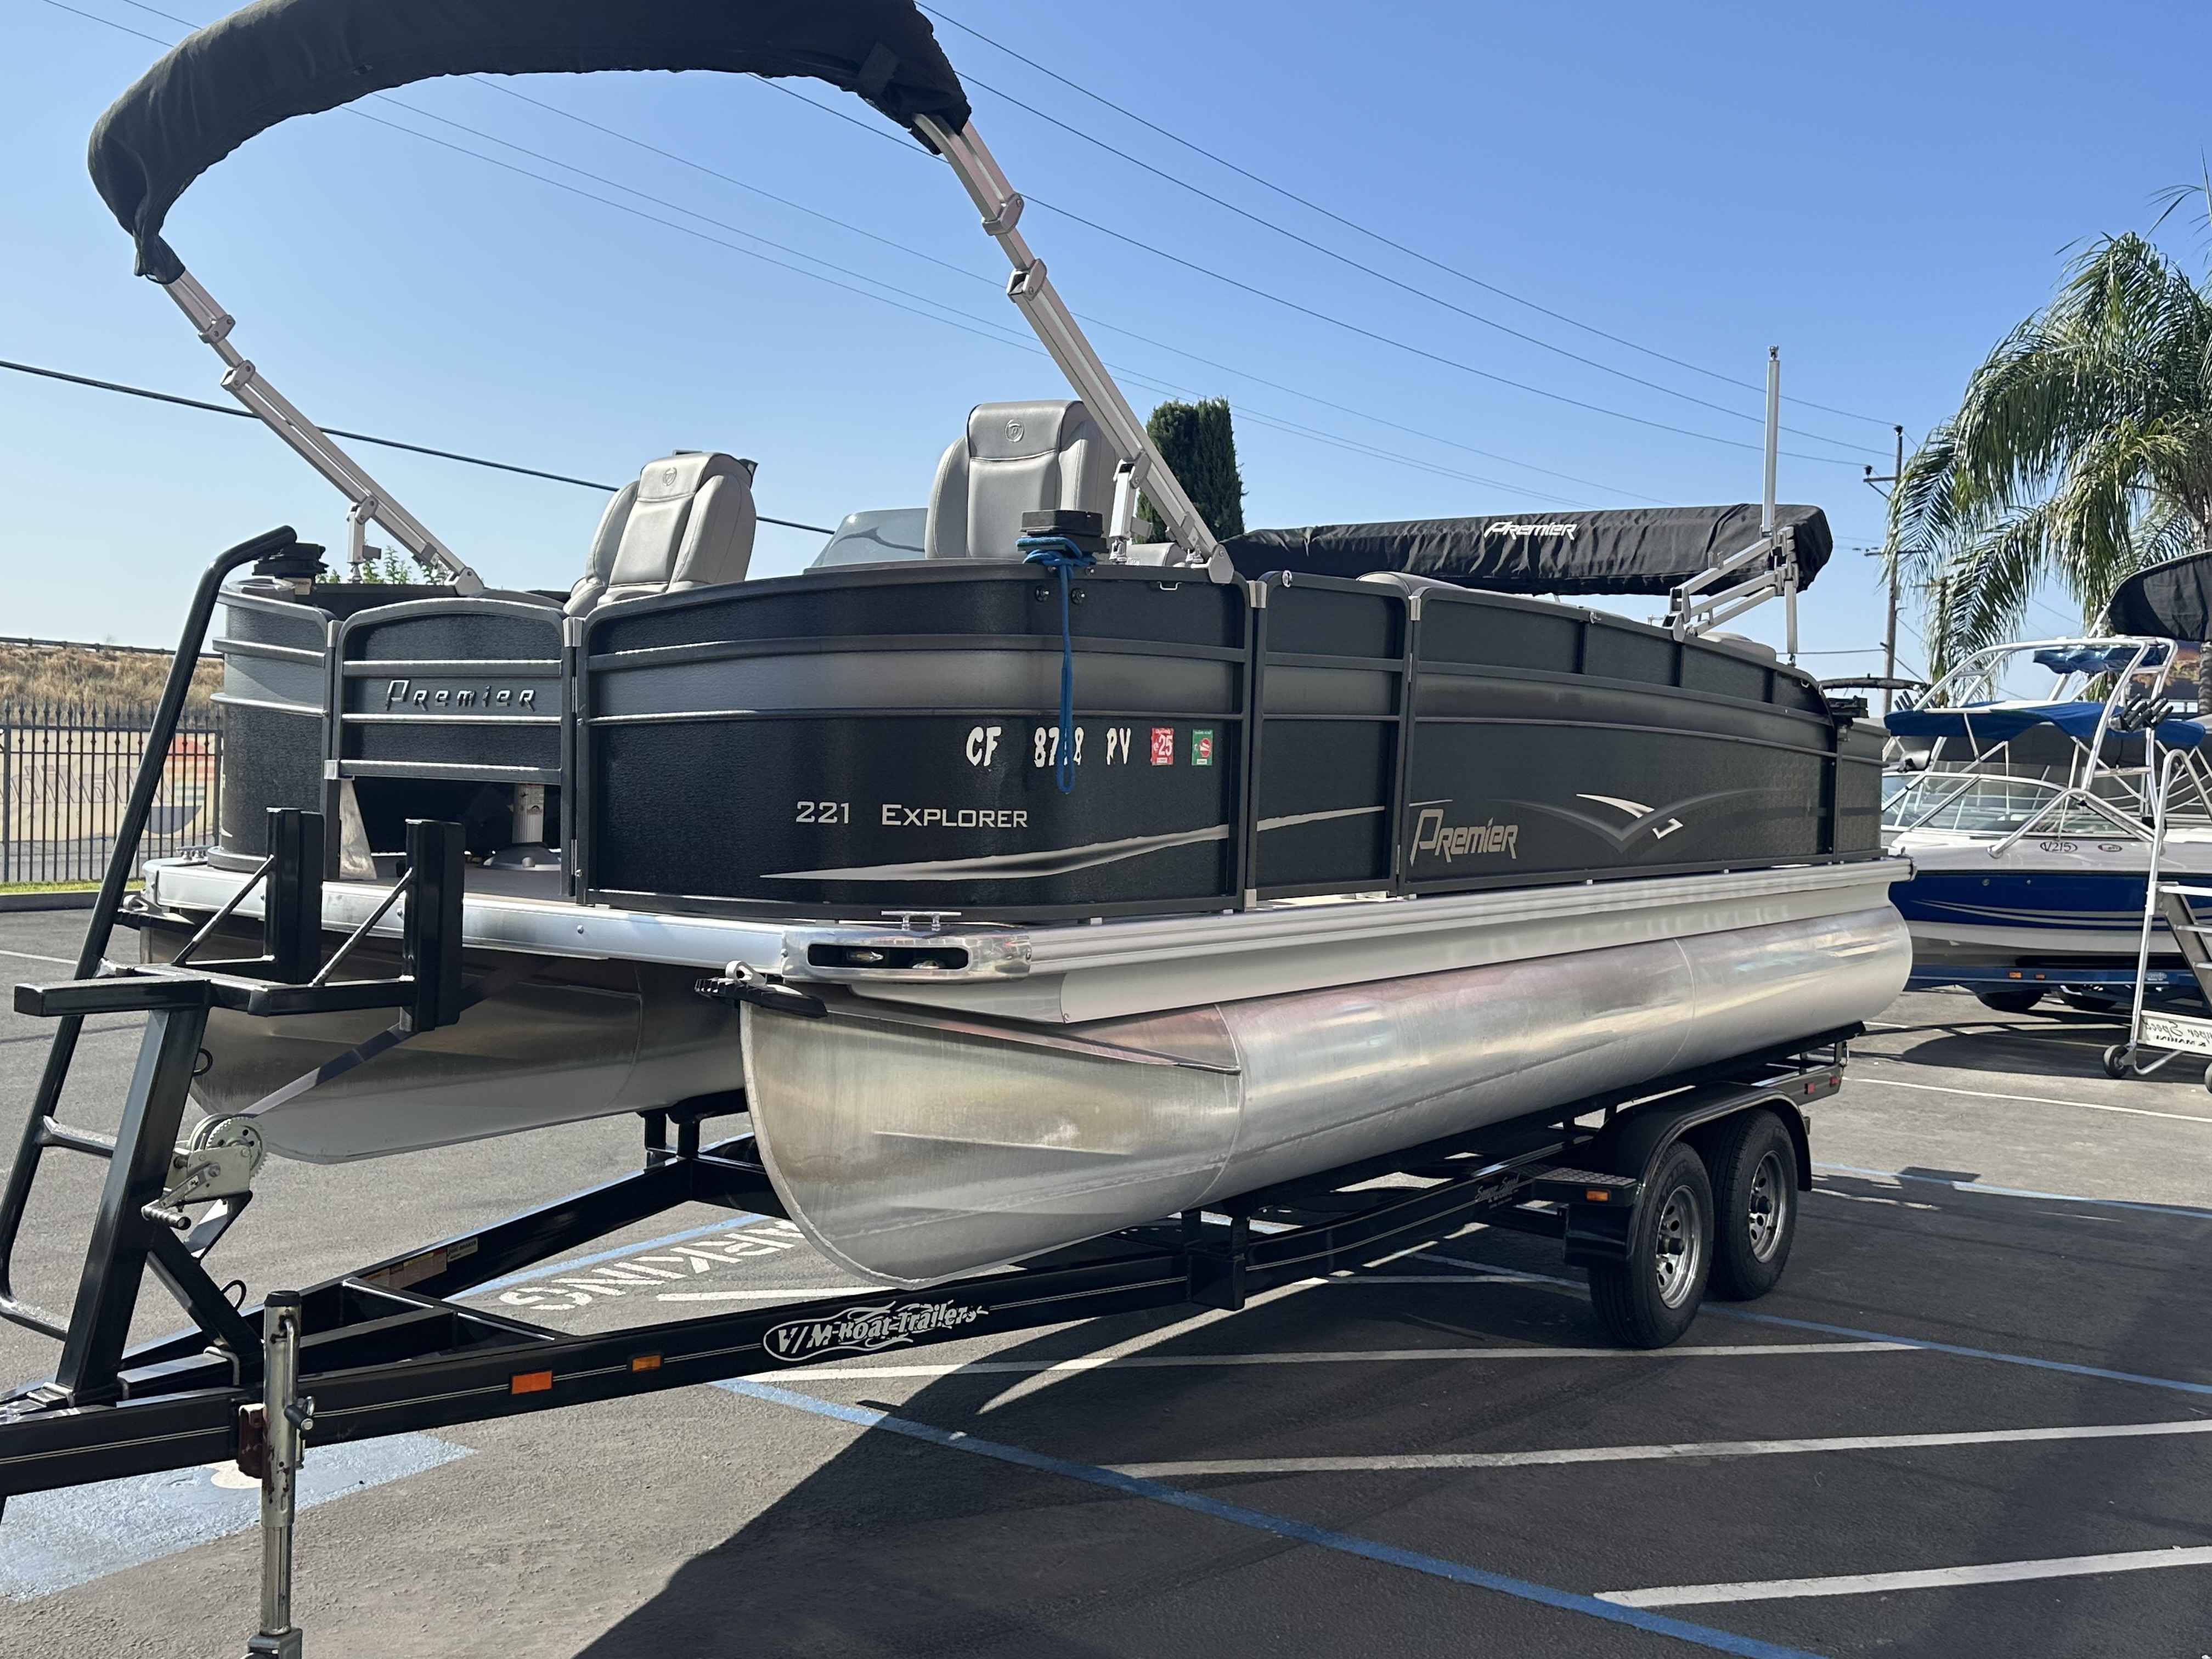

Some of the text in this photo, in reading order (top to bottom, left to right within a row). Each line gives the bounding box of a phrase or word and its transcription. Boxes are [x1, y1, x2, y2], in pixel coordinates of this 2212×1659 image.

[966, 727, 1002, 766] CF
[1033, 727, 1084, 768] 878
[1158, 734, 1173, 756] 25
[795, 801, 850, 823] 221
[2042, 841, 2072, 851] V215
